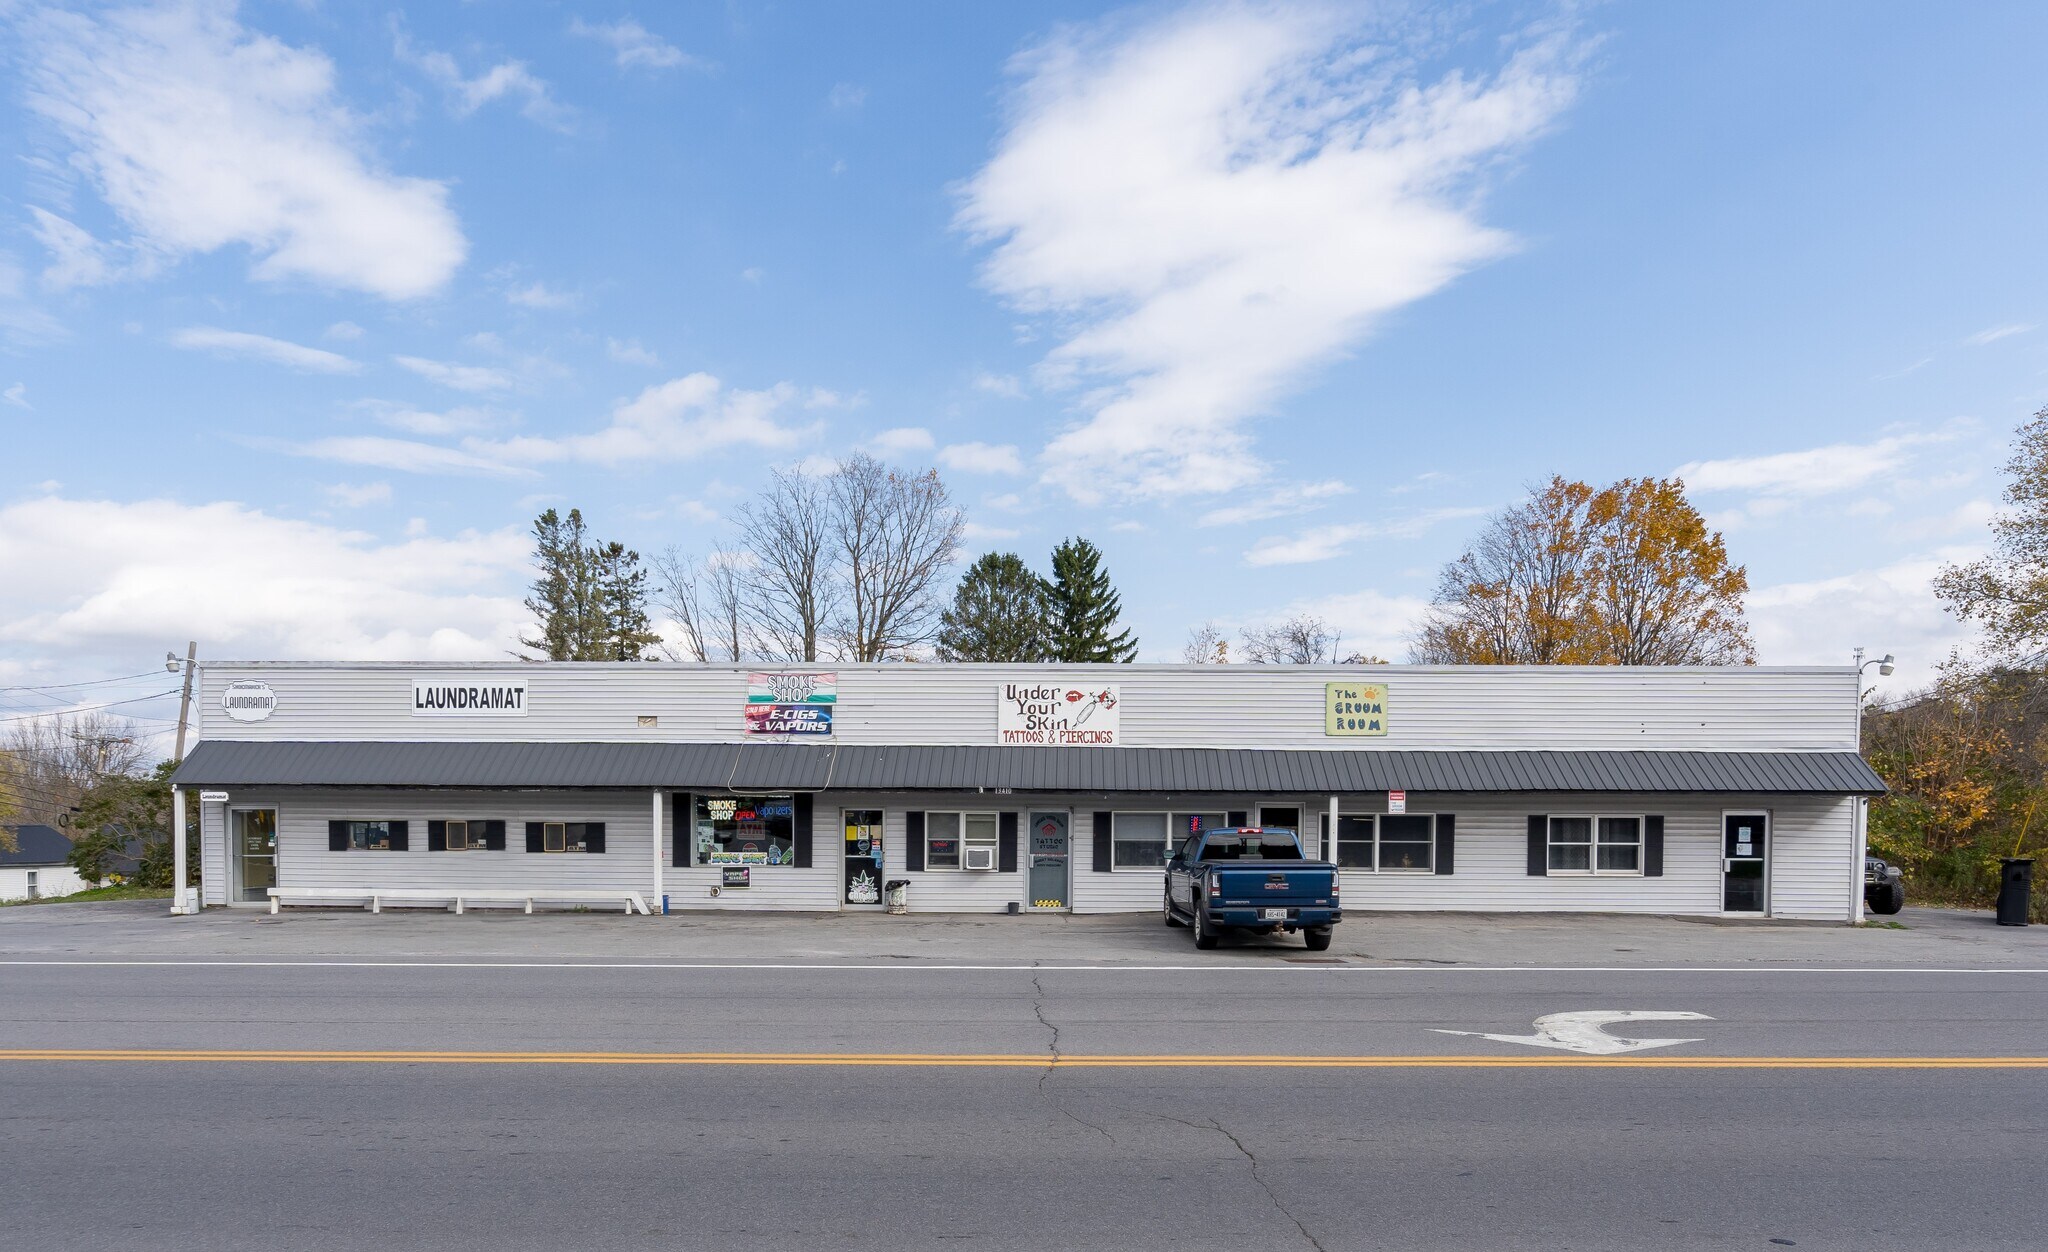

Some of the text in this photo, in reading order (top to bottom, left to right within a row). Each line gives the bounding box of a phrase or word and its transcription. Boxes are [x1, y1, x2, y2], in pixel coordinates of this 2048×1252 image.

[767, 675, 818, 691] SMOKE
[415, 687, 524, 709] LAUNDRAMAT
[772, 687, 814, 703] SHOP
[1006, 684, 1061, 701] Under
[1334, 690, 1357, 699] The
[225, 696, 274, 709] LAUNDRAMAT
[1016, 698, 1062, 716] Your
[1335, 702, 1382, 714] GROOM
[769, 709, 818, 720] E-CIGS
[748, 721, 827, 732] & VAPORS
[1336, 718, 1381, 730] ROOM
[1003, 730, 1113, 744] TATTOOS & PIERCINGS
[707, 800, 737, 811] SMOKE
[711, 811, 733, 820] SHOP
[735, 811, 756, 820] OPEN
[739, 824, 763, 835] ATM
